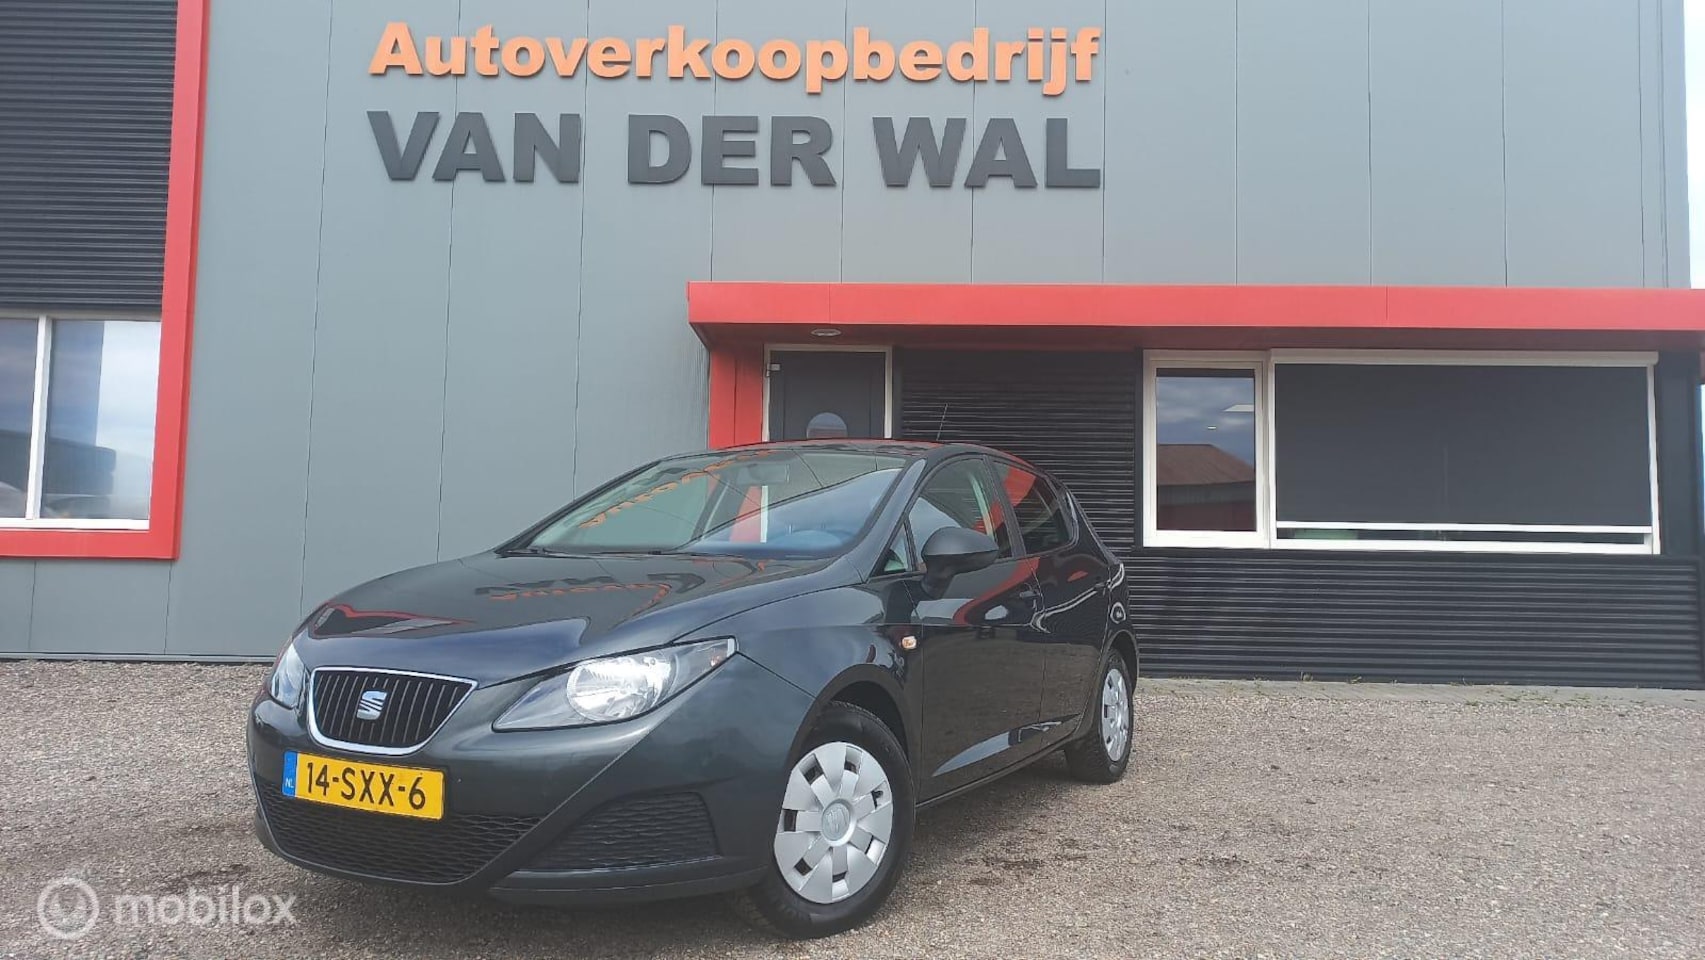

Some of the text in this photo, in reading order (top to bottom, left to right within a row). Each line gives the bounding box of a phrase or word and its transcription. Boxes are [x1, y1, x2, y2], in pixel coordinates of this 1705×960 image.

[367, 22, 1102, 96] Autoverkoopbedrijf
[367, 110, 1102, 190] VAN DER WAL
[306, 761, 427, 811] 14-SXX-6
